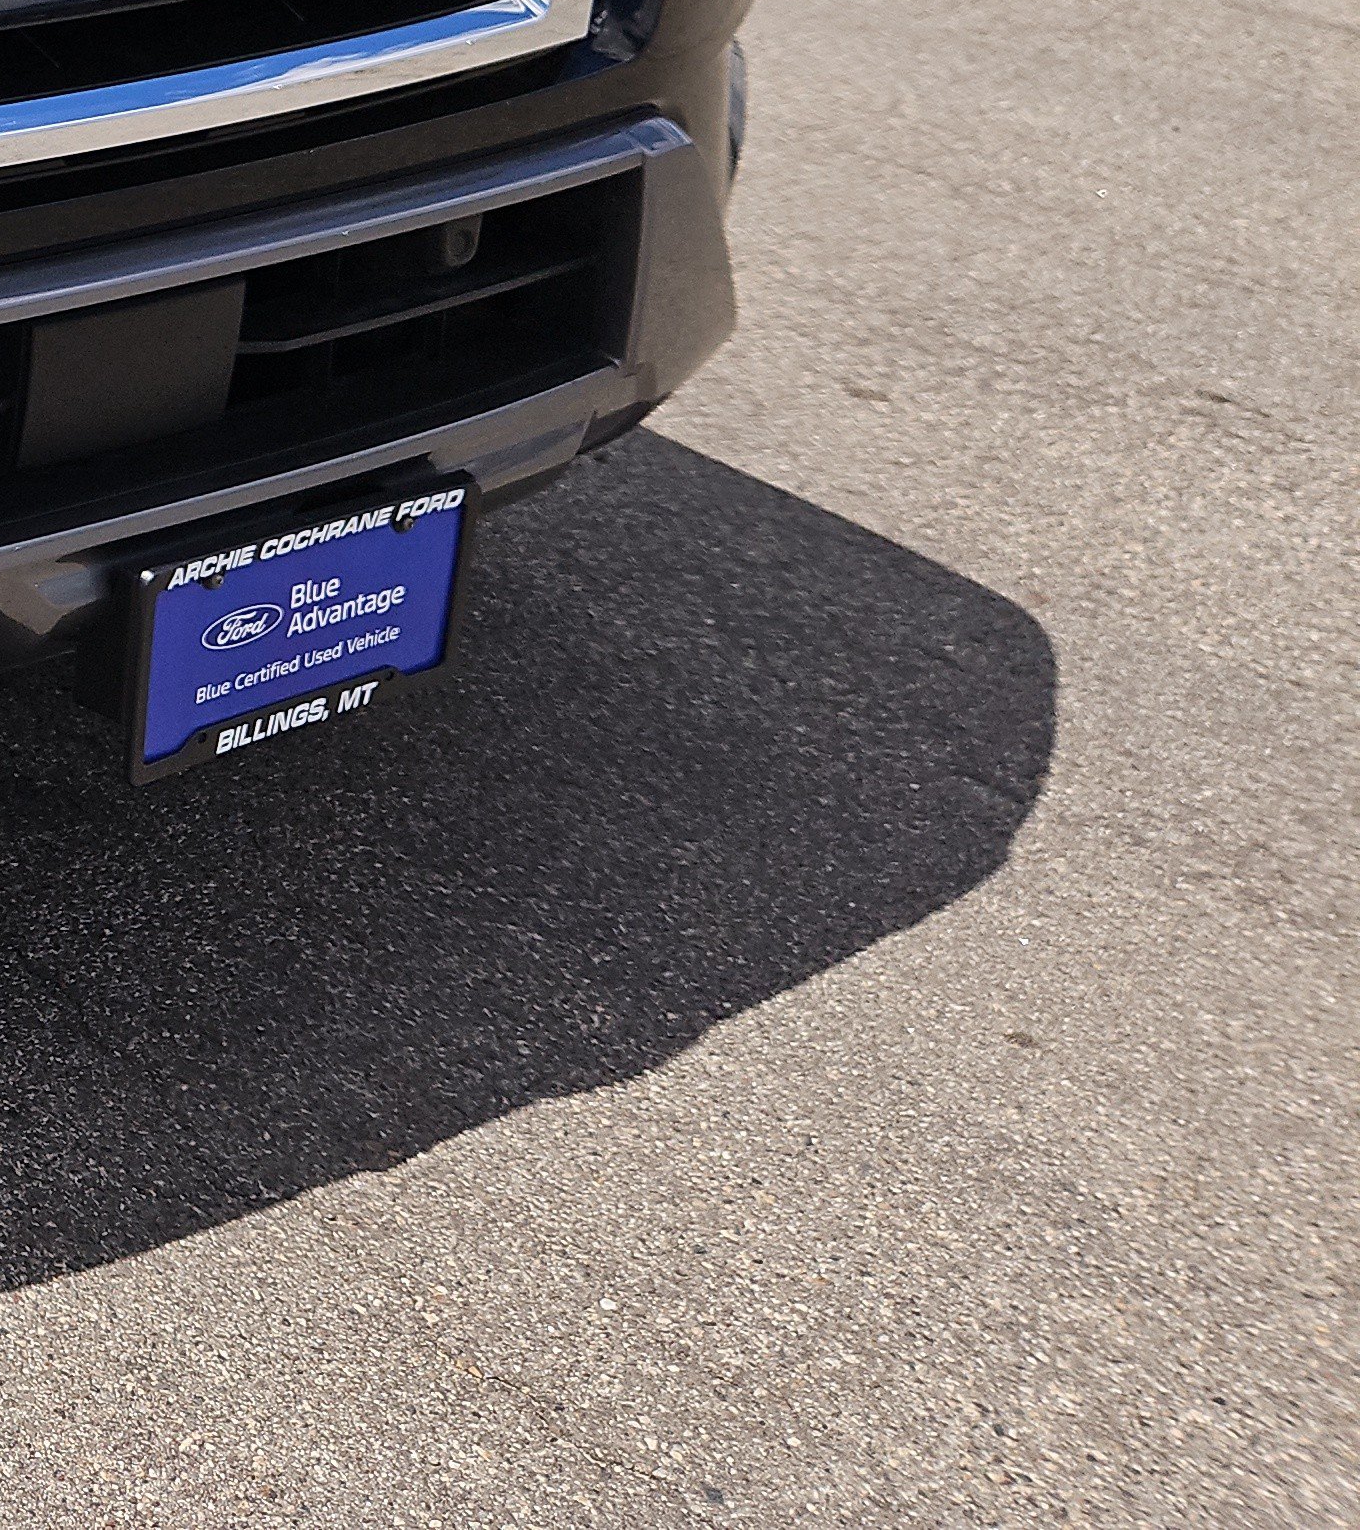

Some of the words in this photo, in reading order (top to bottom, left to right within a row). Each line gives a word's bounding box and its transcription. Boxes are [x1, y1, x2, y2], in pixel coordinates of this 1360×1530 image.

[167, 544, 257, 590] ARCHIE
[259, 506, 395, 560] COCHRANE
[395, 488, 466, 521] FORD
[286, 585, 406, 638] Advantage
[290, 576, 341, 610] Blue
[195, 680, 231, 705] Blue
[235, 658, 300, 691] Certified
[304, 641, 343, 670] Used
[347, 625, 402, 655] Vehicle
[215, 697, 330, 755] BILLINGS,
[337, 681, 379, 714] MT
